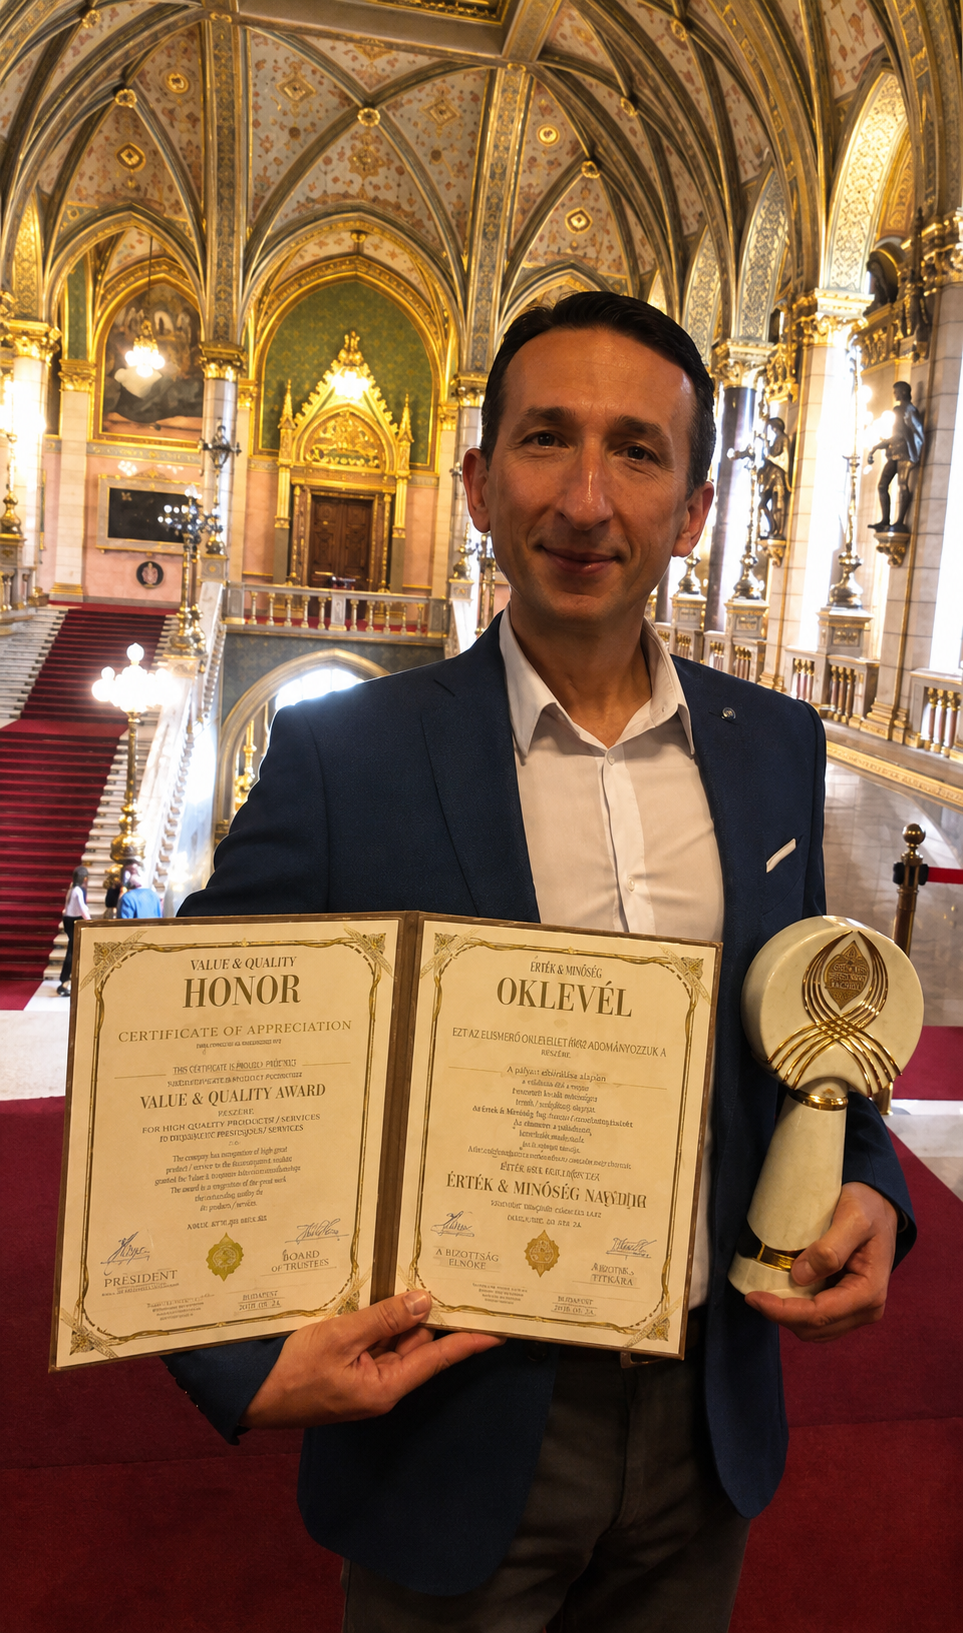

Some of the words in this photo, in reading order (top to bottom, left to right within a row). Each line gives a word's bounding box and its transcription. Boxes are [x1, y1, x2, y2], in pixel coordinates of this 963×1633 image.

[190, 958, 230, 971] VALUE
[232, 958, 242, 970] &
[245, 956, 297, 970] QUALITY
[530, 956, 556, 974] ÉRTÉK
[557, 964, 564, 974] &
[182, 974, 301, 1008] HONOR
[496, 976, 632, 1018] OKLEVÉL
[118, 1026, 218, 1043] CERTIFICATE
[223, 1025, 242, 1036] OF
[246, 1020, 352, 1036] APPRECIATION
[452, 1027, 468, 1037] EZT
[660, 1048, 666, 1058] A
[140, 1093, 188, 1109] VALUE
[192, 1092, 204, 1105] &
[208, 1087, 272, 1106] QUALITY
[276, 1084, 326, 1099] AWARD
[142, 1126, 160, 1134] FOR
[163, 1124, 185, 1132] HIGH
[188, 1121, 225, 1130] QUALITY
[446, 1171, 494, 1192] ÉRTÉK
[498, 1180, 509, 1192] &
[282, 1250, 320, 1261] BOARD
[284, 1258, 329, 1270] TRUSTEES
[436, 1248, 442, 1256] A
[446, 1249, 499, 1262] BIZOTTSÁG
[104, 1270, 178, 1287] PRESIDENT
